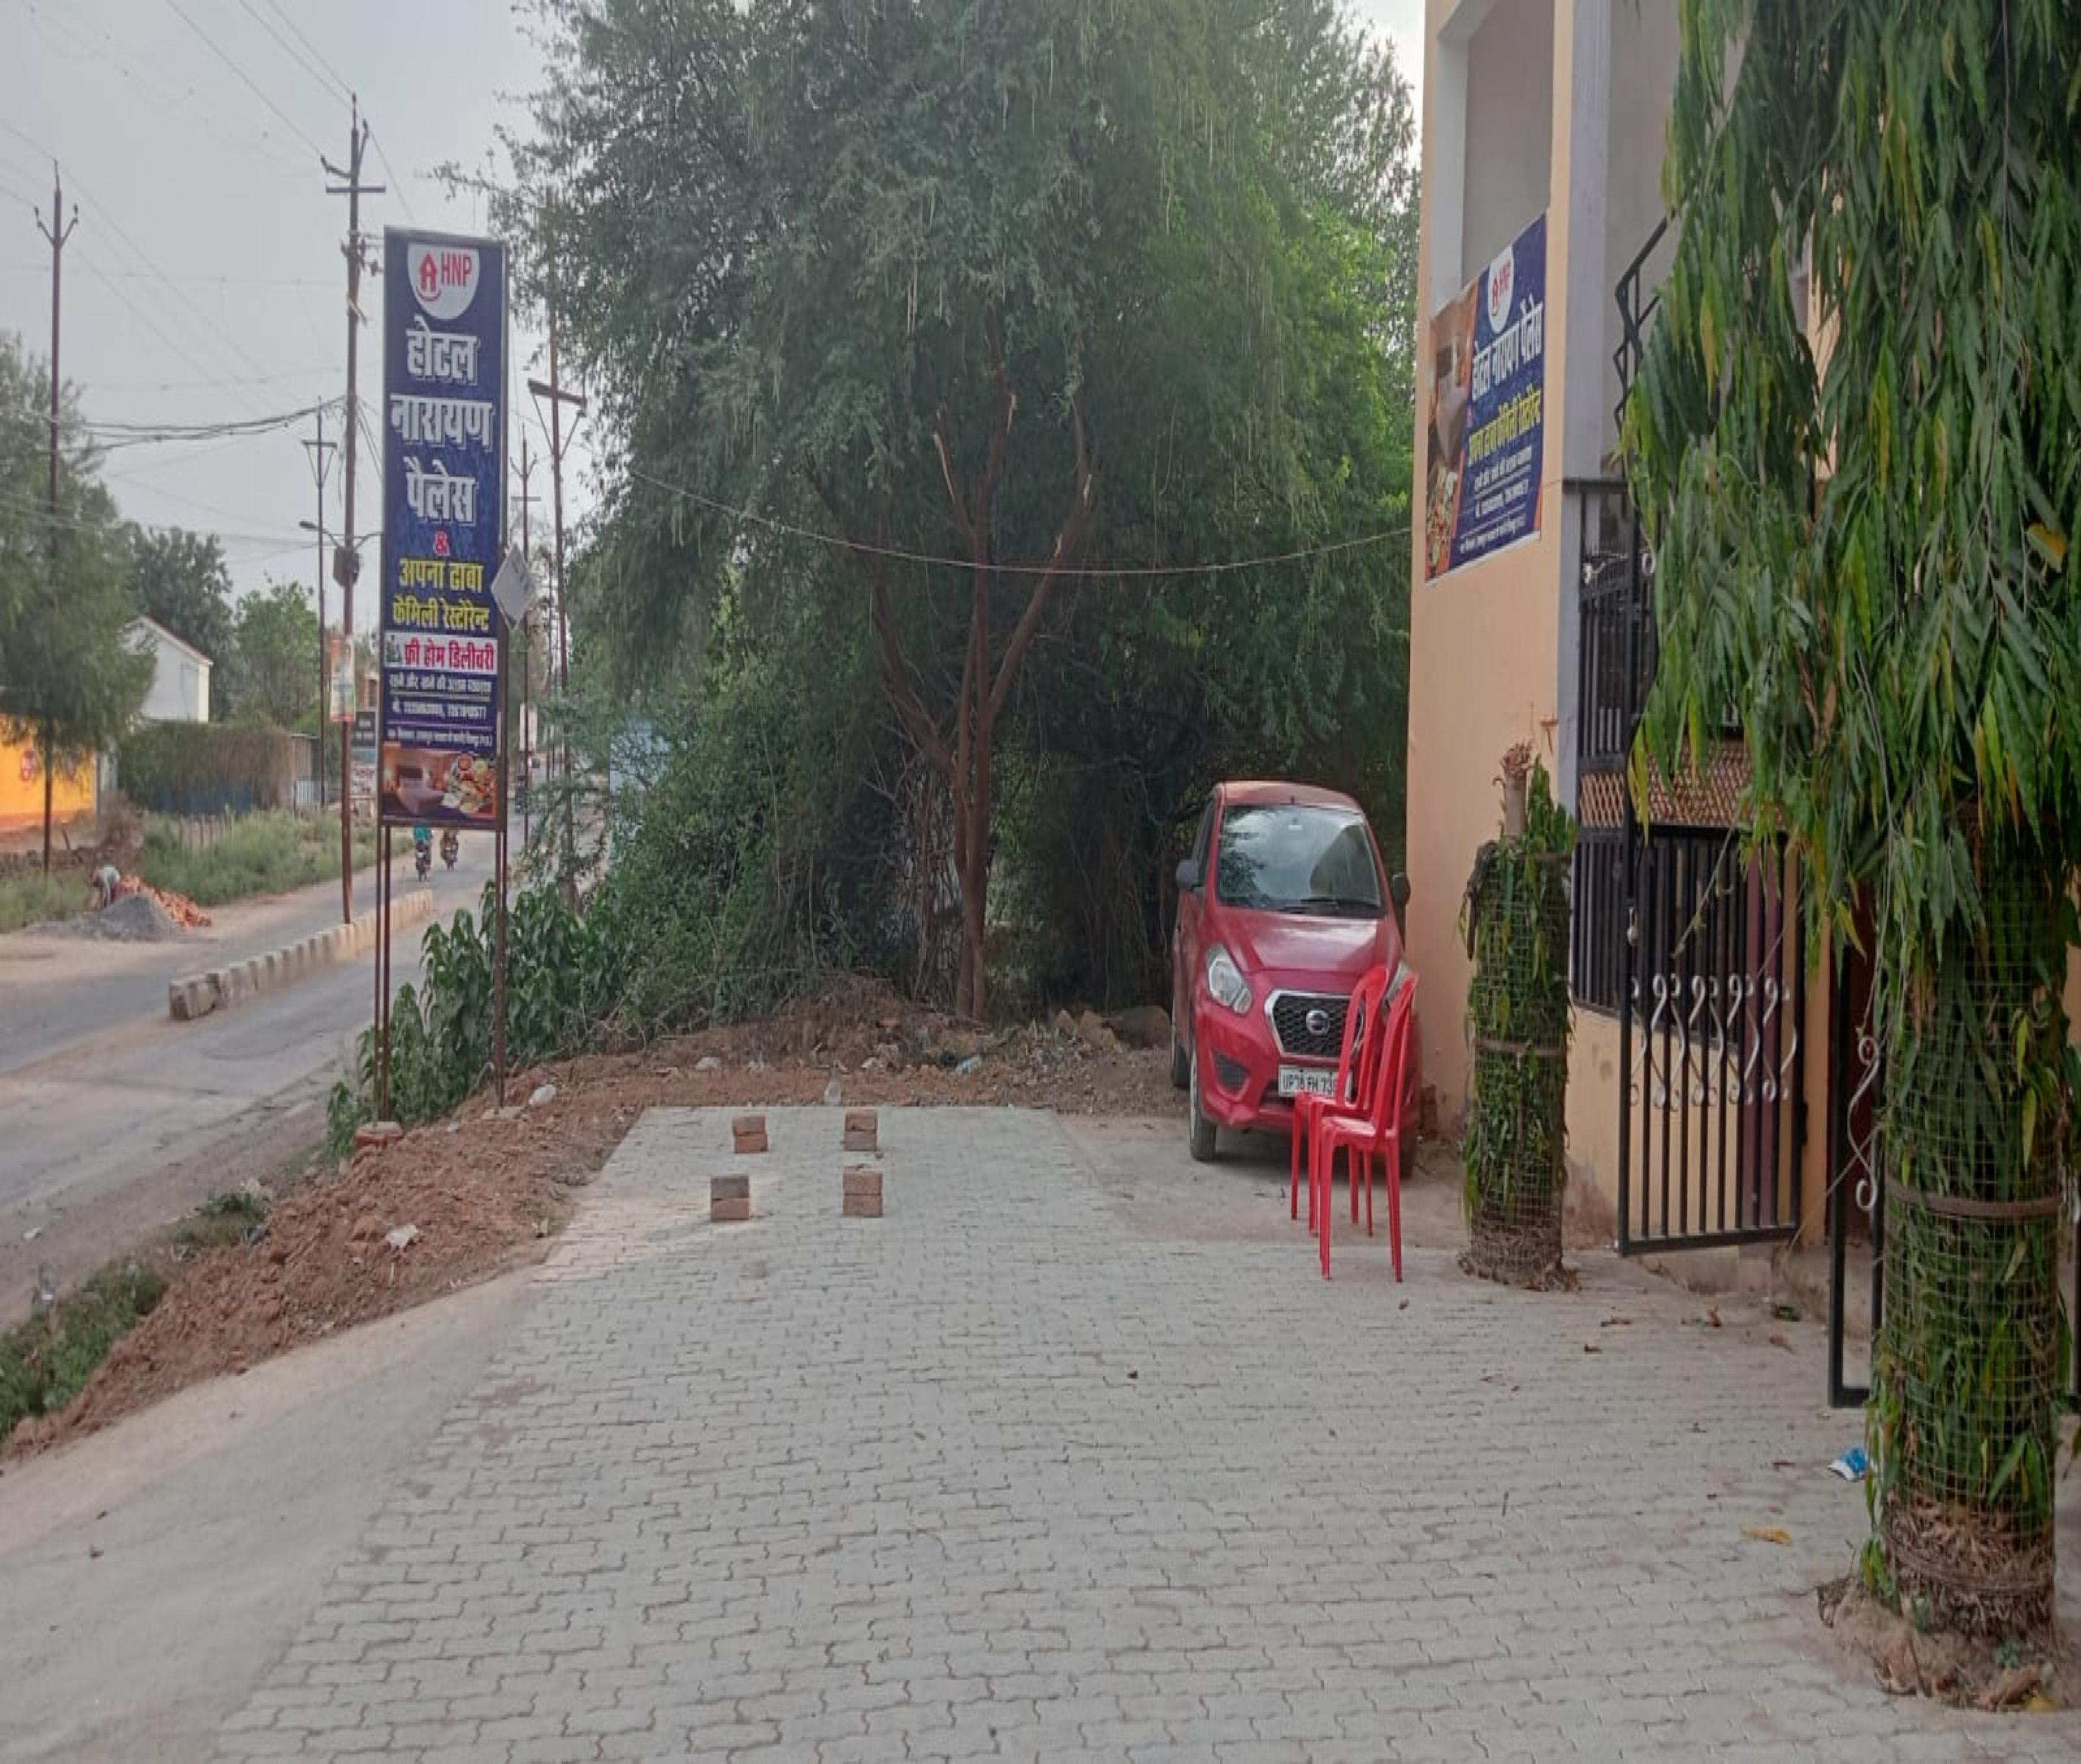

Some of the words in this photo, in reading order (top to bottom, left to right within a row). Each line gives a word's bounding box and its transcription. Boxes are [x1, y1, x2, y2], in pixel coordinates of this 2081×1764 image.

[441, 251, 472, 287] HNP
[407, 314, 479, 385] होटल
[389, 394, 495, 452] नारायण
[403, 456, 479, 527] पैलेस
[433, 530, 450, 556] &
[399, 558, 445, 589] अपना
[424, 637, 445, 668] होम
[449, 640, 494, 671] डिलीवरी
